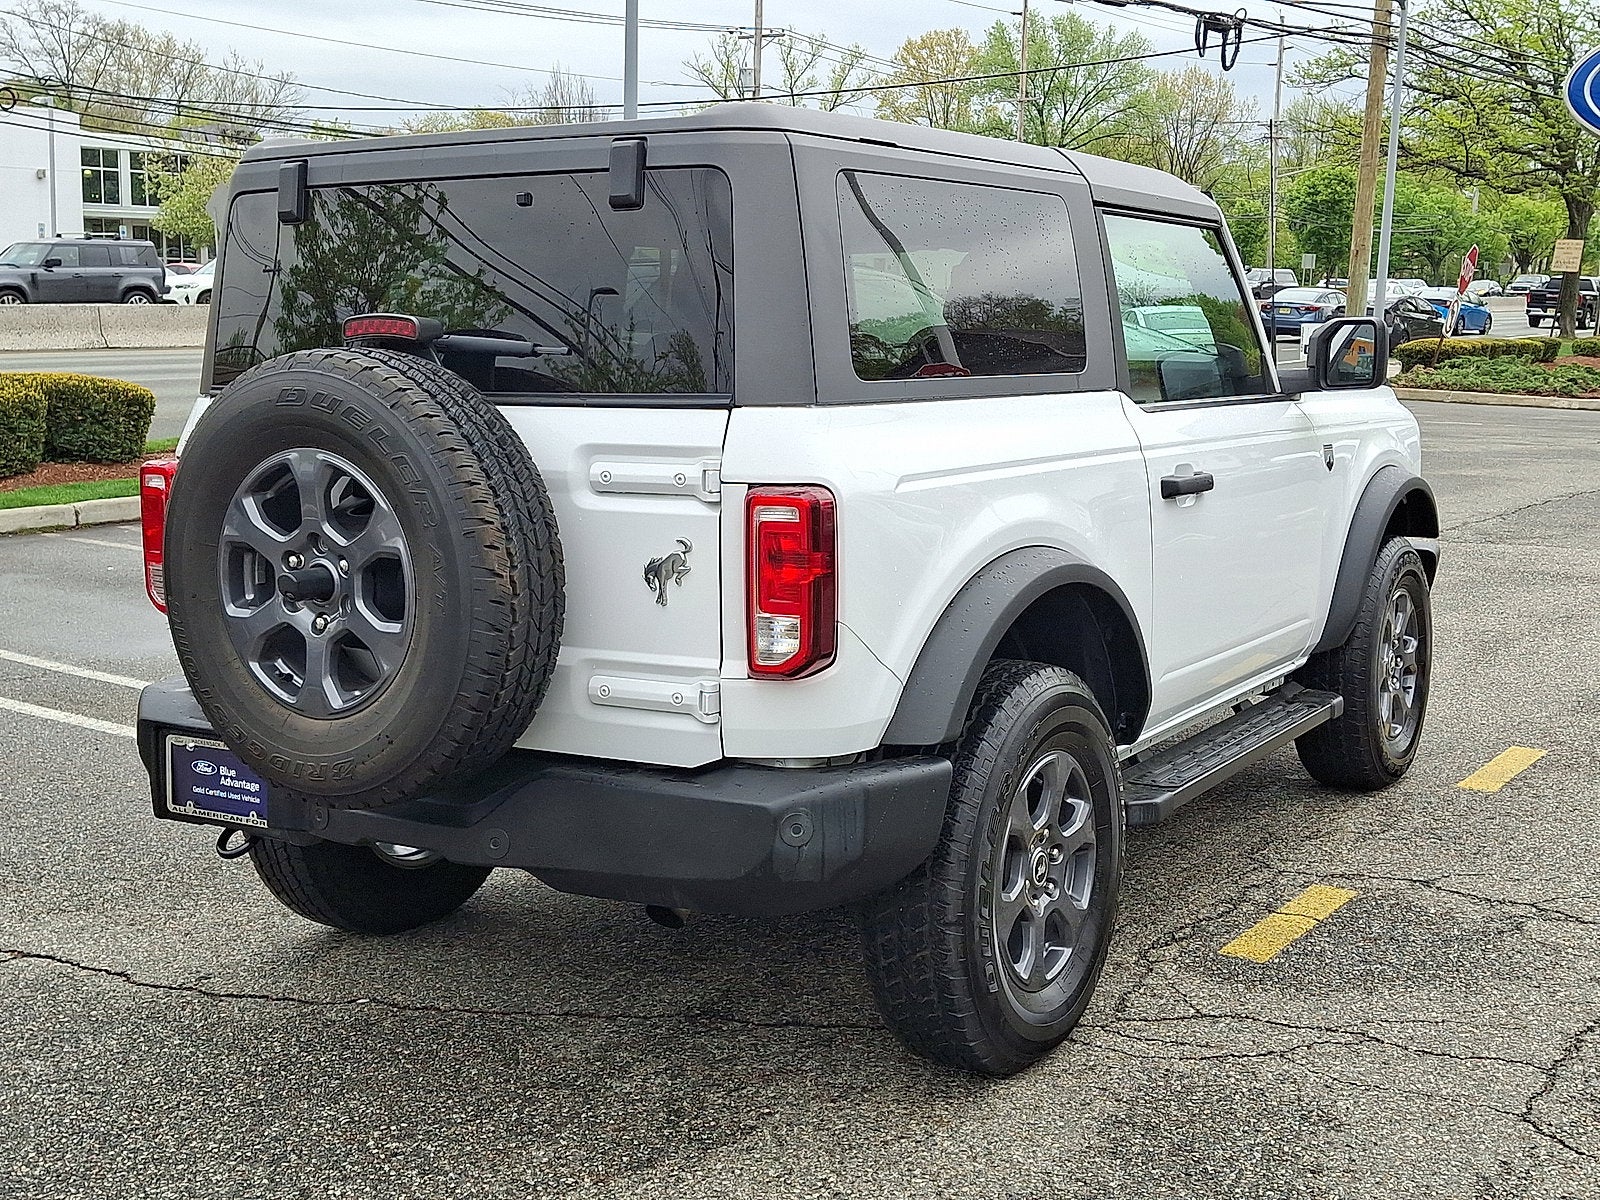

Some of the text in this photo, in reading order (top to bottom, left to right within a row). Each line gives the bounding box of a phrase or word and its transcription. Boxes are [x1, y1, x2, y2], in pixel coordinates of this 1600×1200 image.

[275, 386, 440, 530] DUELER
[196, 762, 237, 777] Ford Blue
[219, 776, 260, 792] Advantage
[192, 785, 261, 804] Gold Certified Used Vehicle
[171, 806, 189, 814] ALL
[191, 809, 243, 823] AMERICAN
[978, 770, 1013, 993] DUELER
